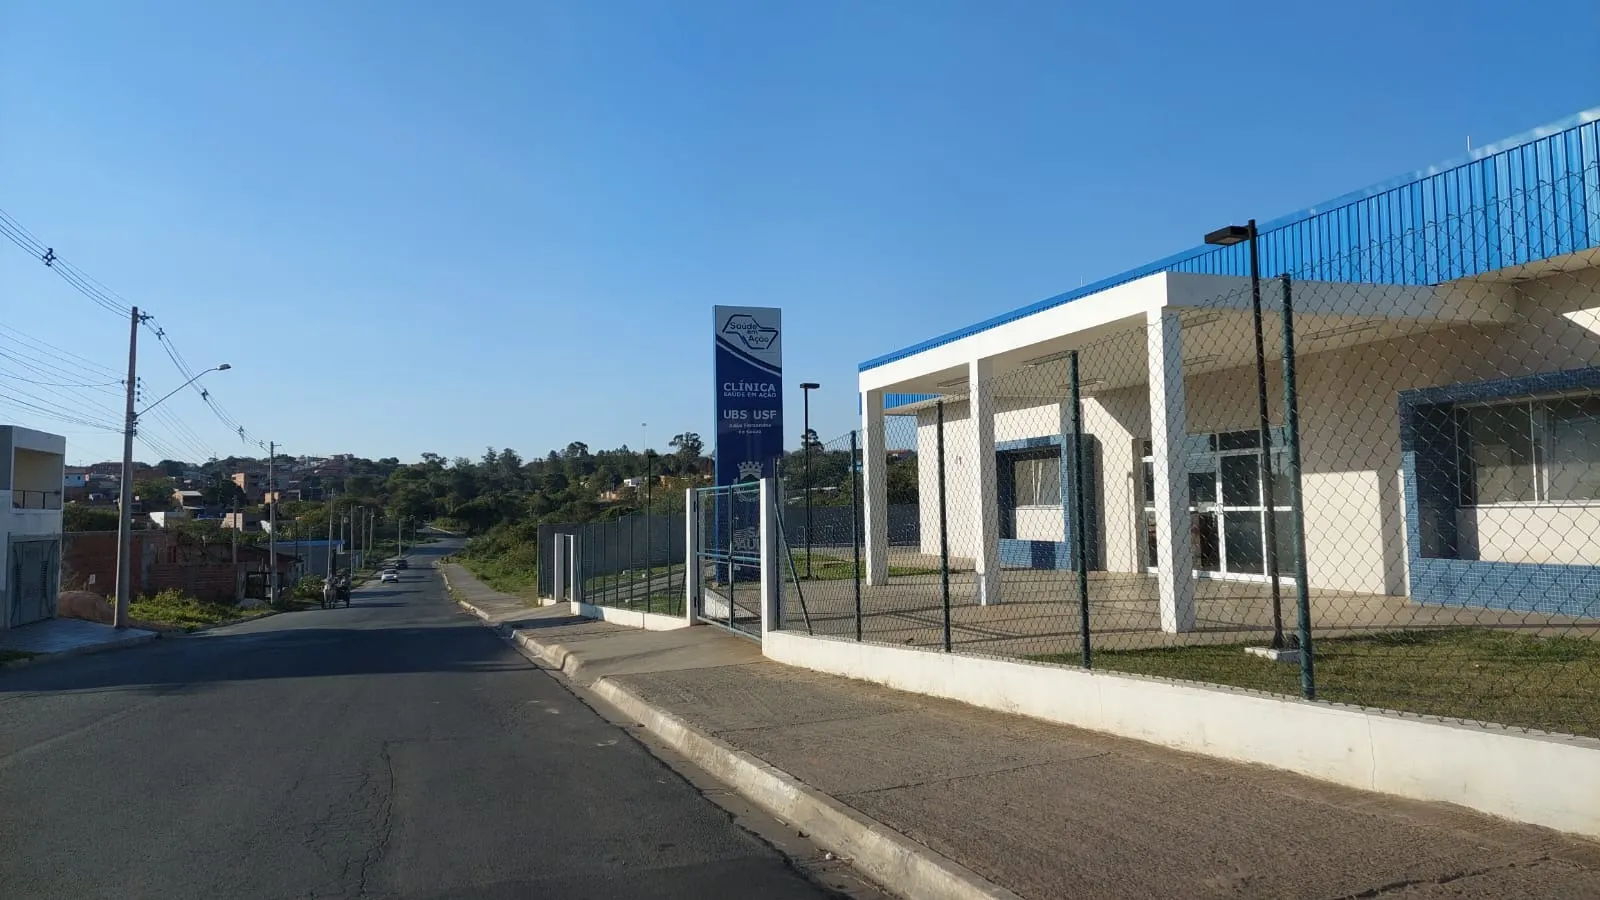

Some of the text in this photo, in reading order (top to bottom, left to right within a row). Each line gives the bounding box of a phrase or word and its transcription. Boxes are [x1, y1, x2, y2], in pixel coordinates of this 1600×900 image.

[730, 321, 757, 329] Saúde
[723, 380, 776, 391] CLÍNICA
[723, 409, 777, 420] UBS USF
